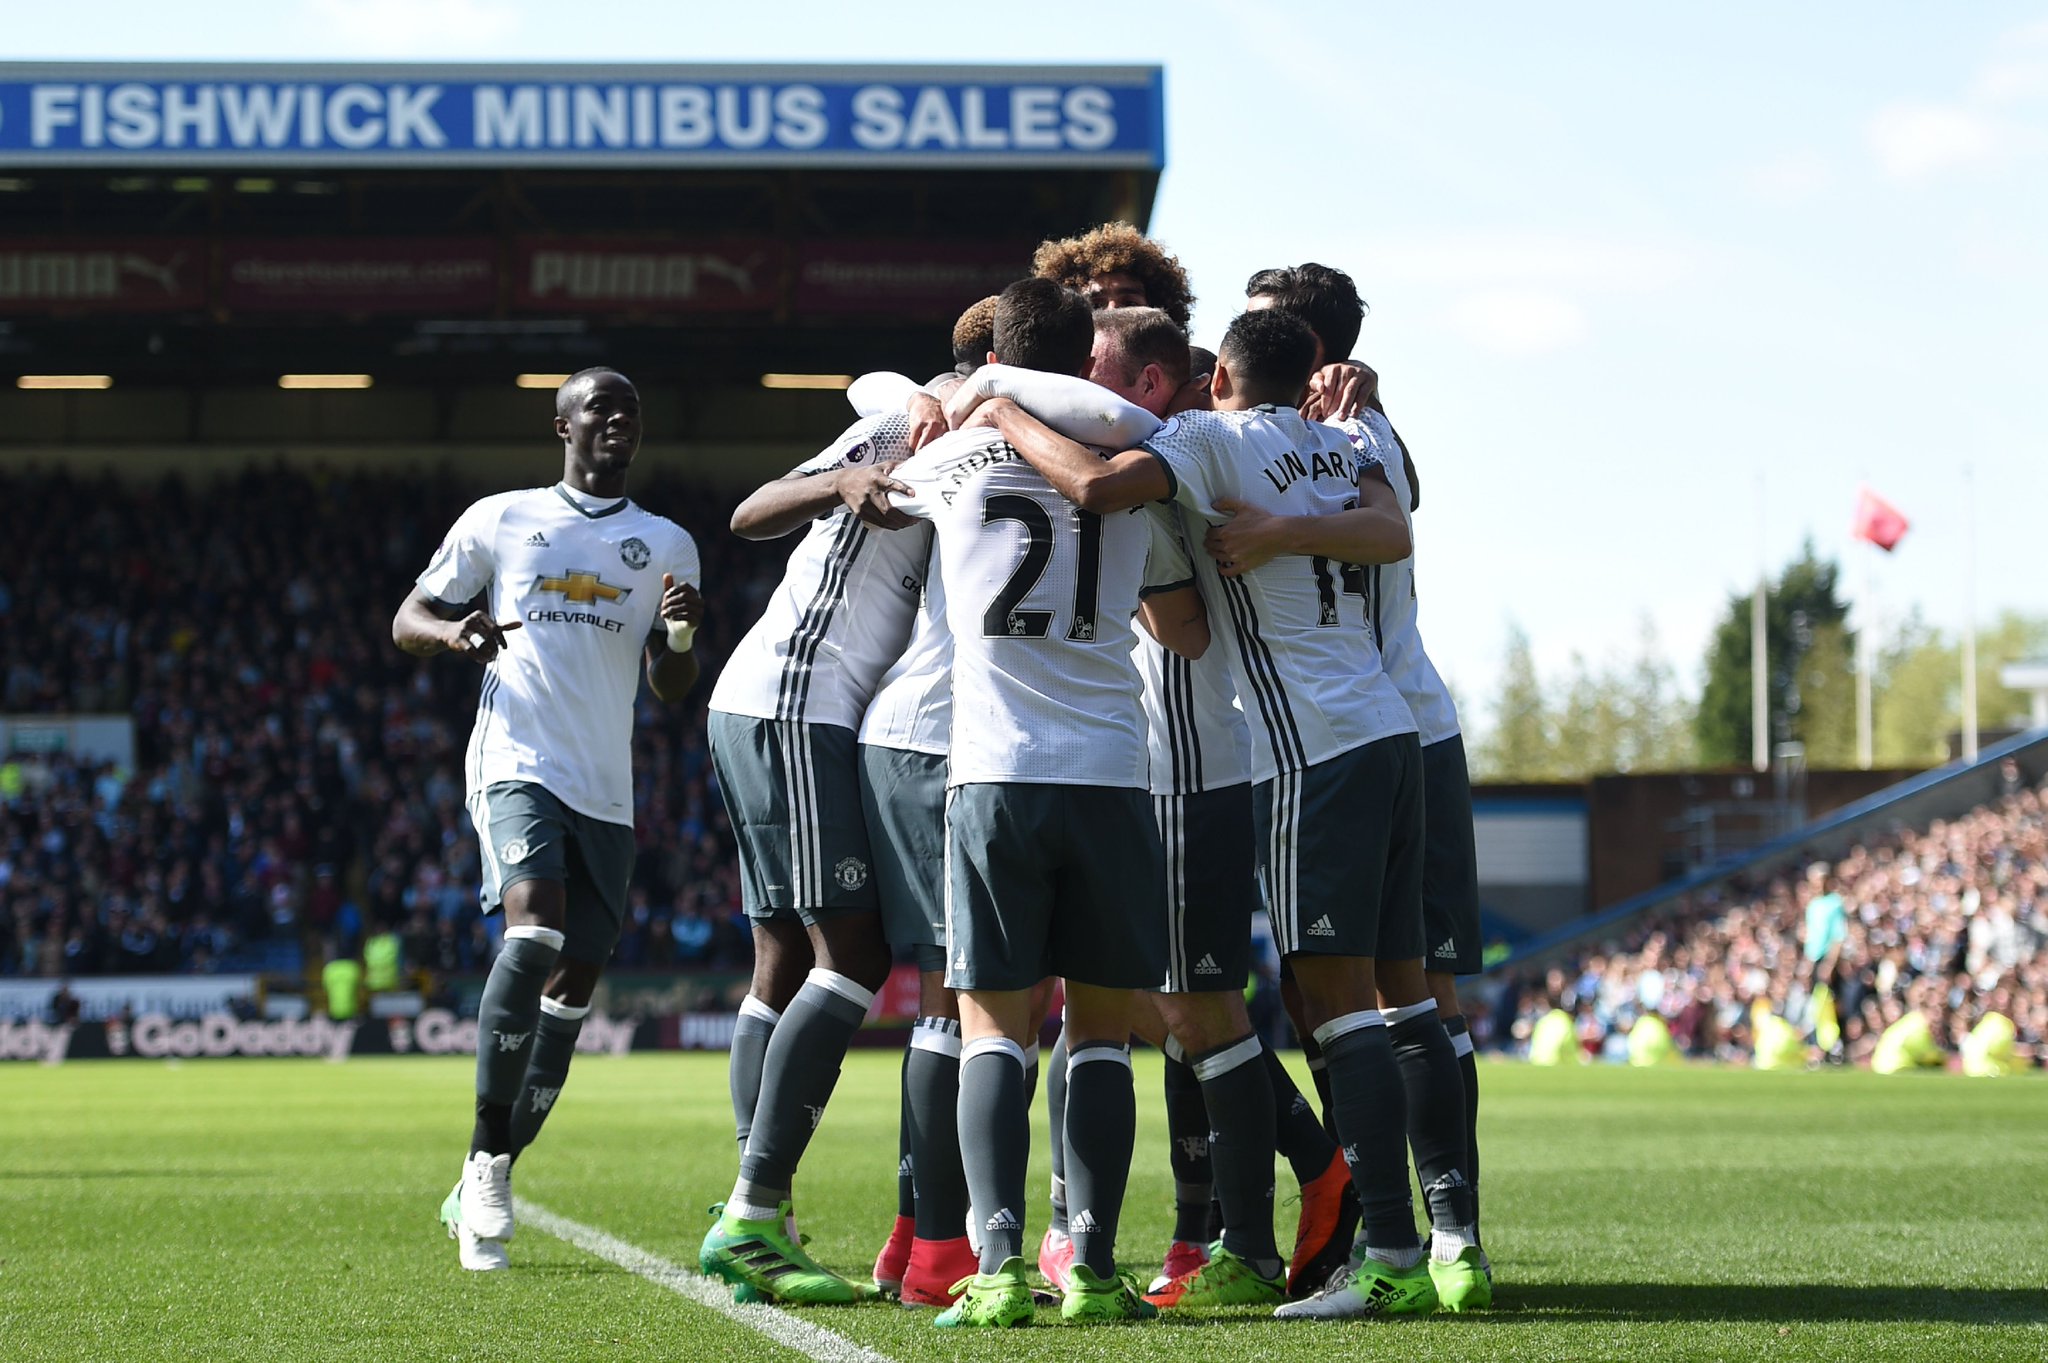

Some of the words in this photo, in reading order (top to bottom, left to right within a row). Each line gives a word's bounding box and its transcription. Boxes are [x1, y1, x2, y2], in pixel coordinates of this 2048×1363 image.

[30, 84, 448, 148] FISHWICK
[474, 86, 829, 148] MINIBUS
[850, 87, 1117, 149] SALES
[530, 252, 698, 297] PUMA
[1264, 450, 1359, 494] LINARD
[981, 492, 1105, 643] 21
[528, 609, 625, 634] CHEVROLET
[1307, 927, 1335, 937] adidas
[1194, 966, 1222, 975] adidas
[131, 1011, 359, 1064] GoDaddy
[985, 1221, 1021, 1231] adidas
[1364, 1288, 1408, 1316] adidas
